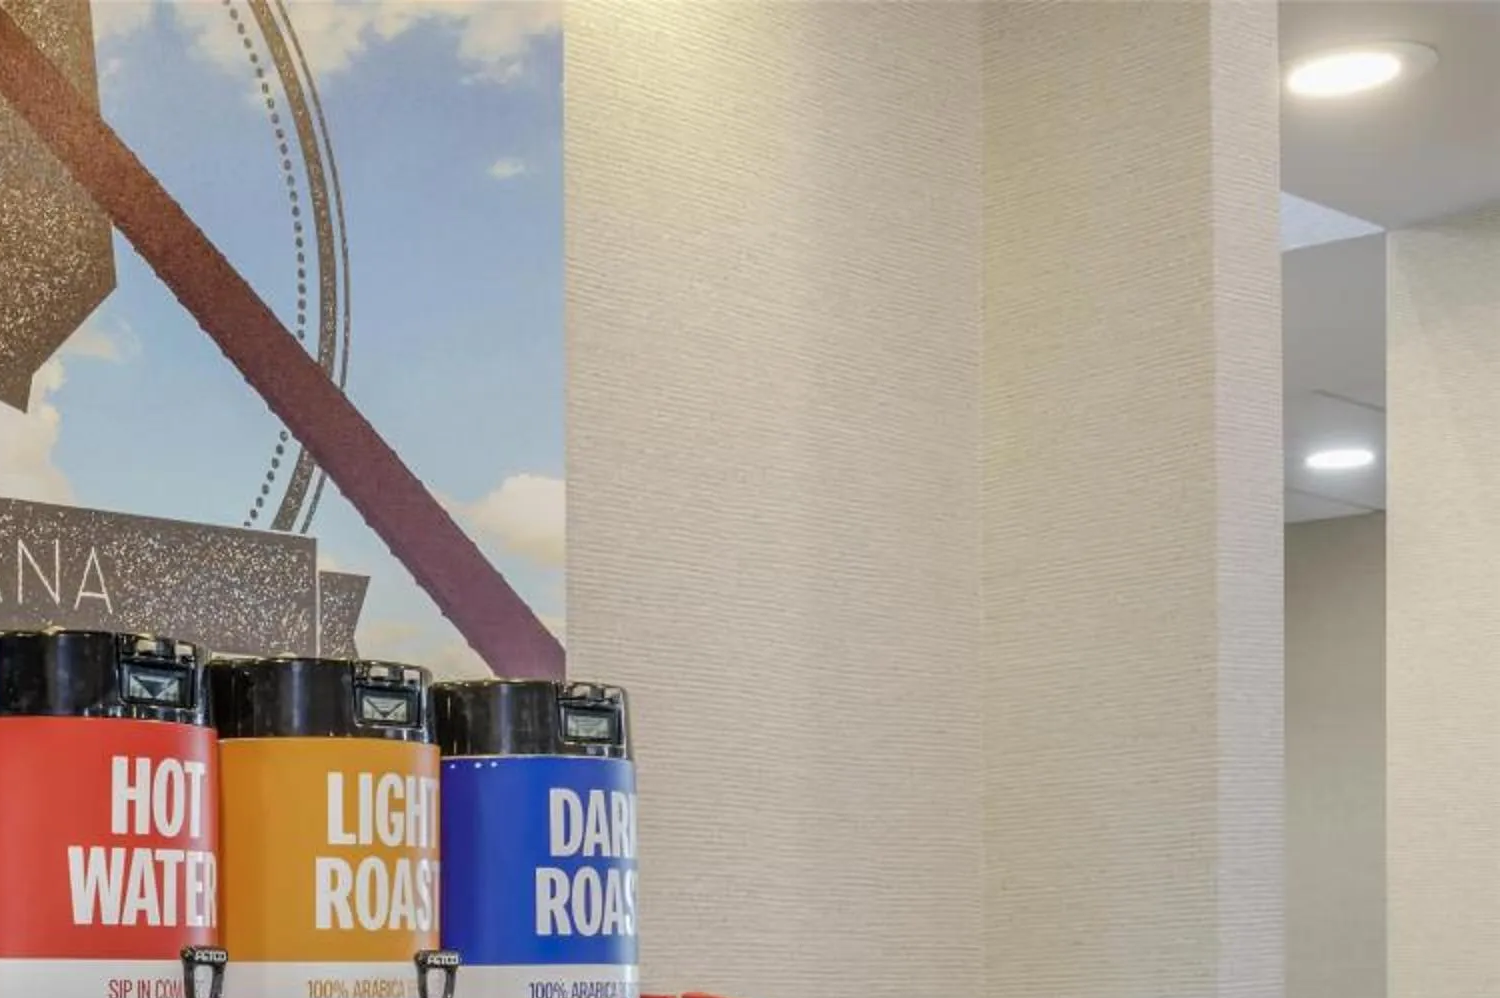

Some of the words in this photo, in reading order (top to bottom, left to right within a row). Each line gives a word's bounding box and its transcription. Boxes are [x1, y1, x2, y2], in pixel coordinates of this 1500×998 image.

[111, 755, 205, 839] HOT
[327, 771, 439, 848] LIGHT
[67, 845, 217, 929] WATER
[535, 866, 639, 938] ROAS
